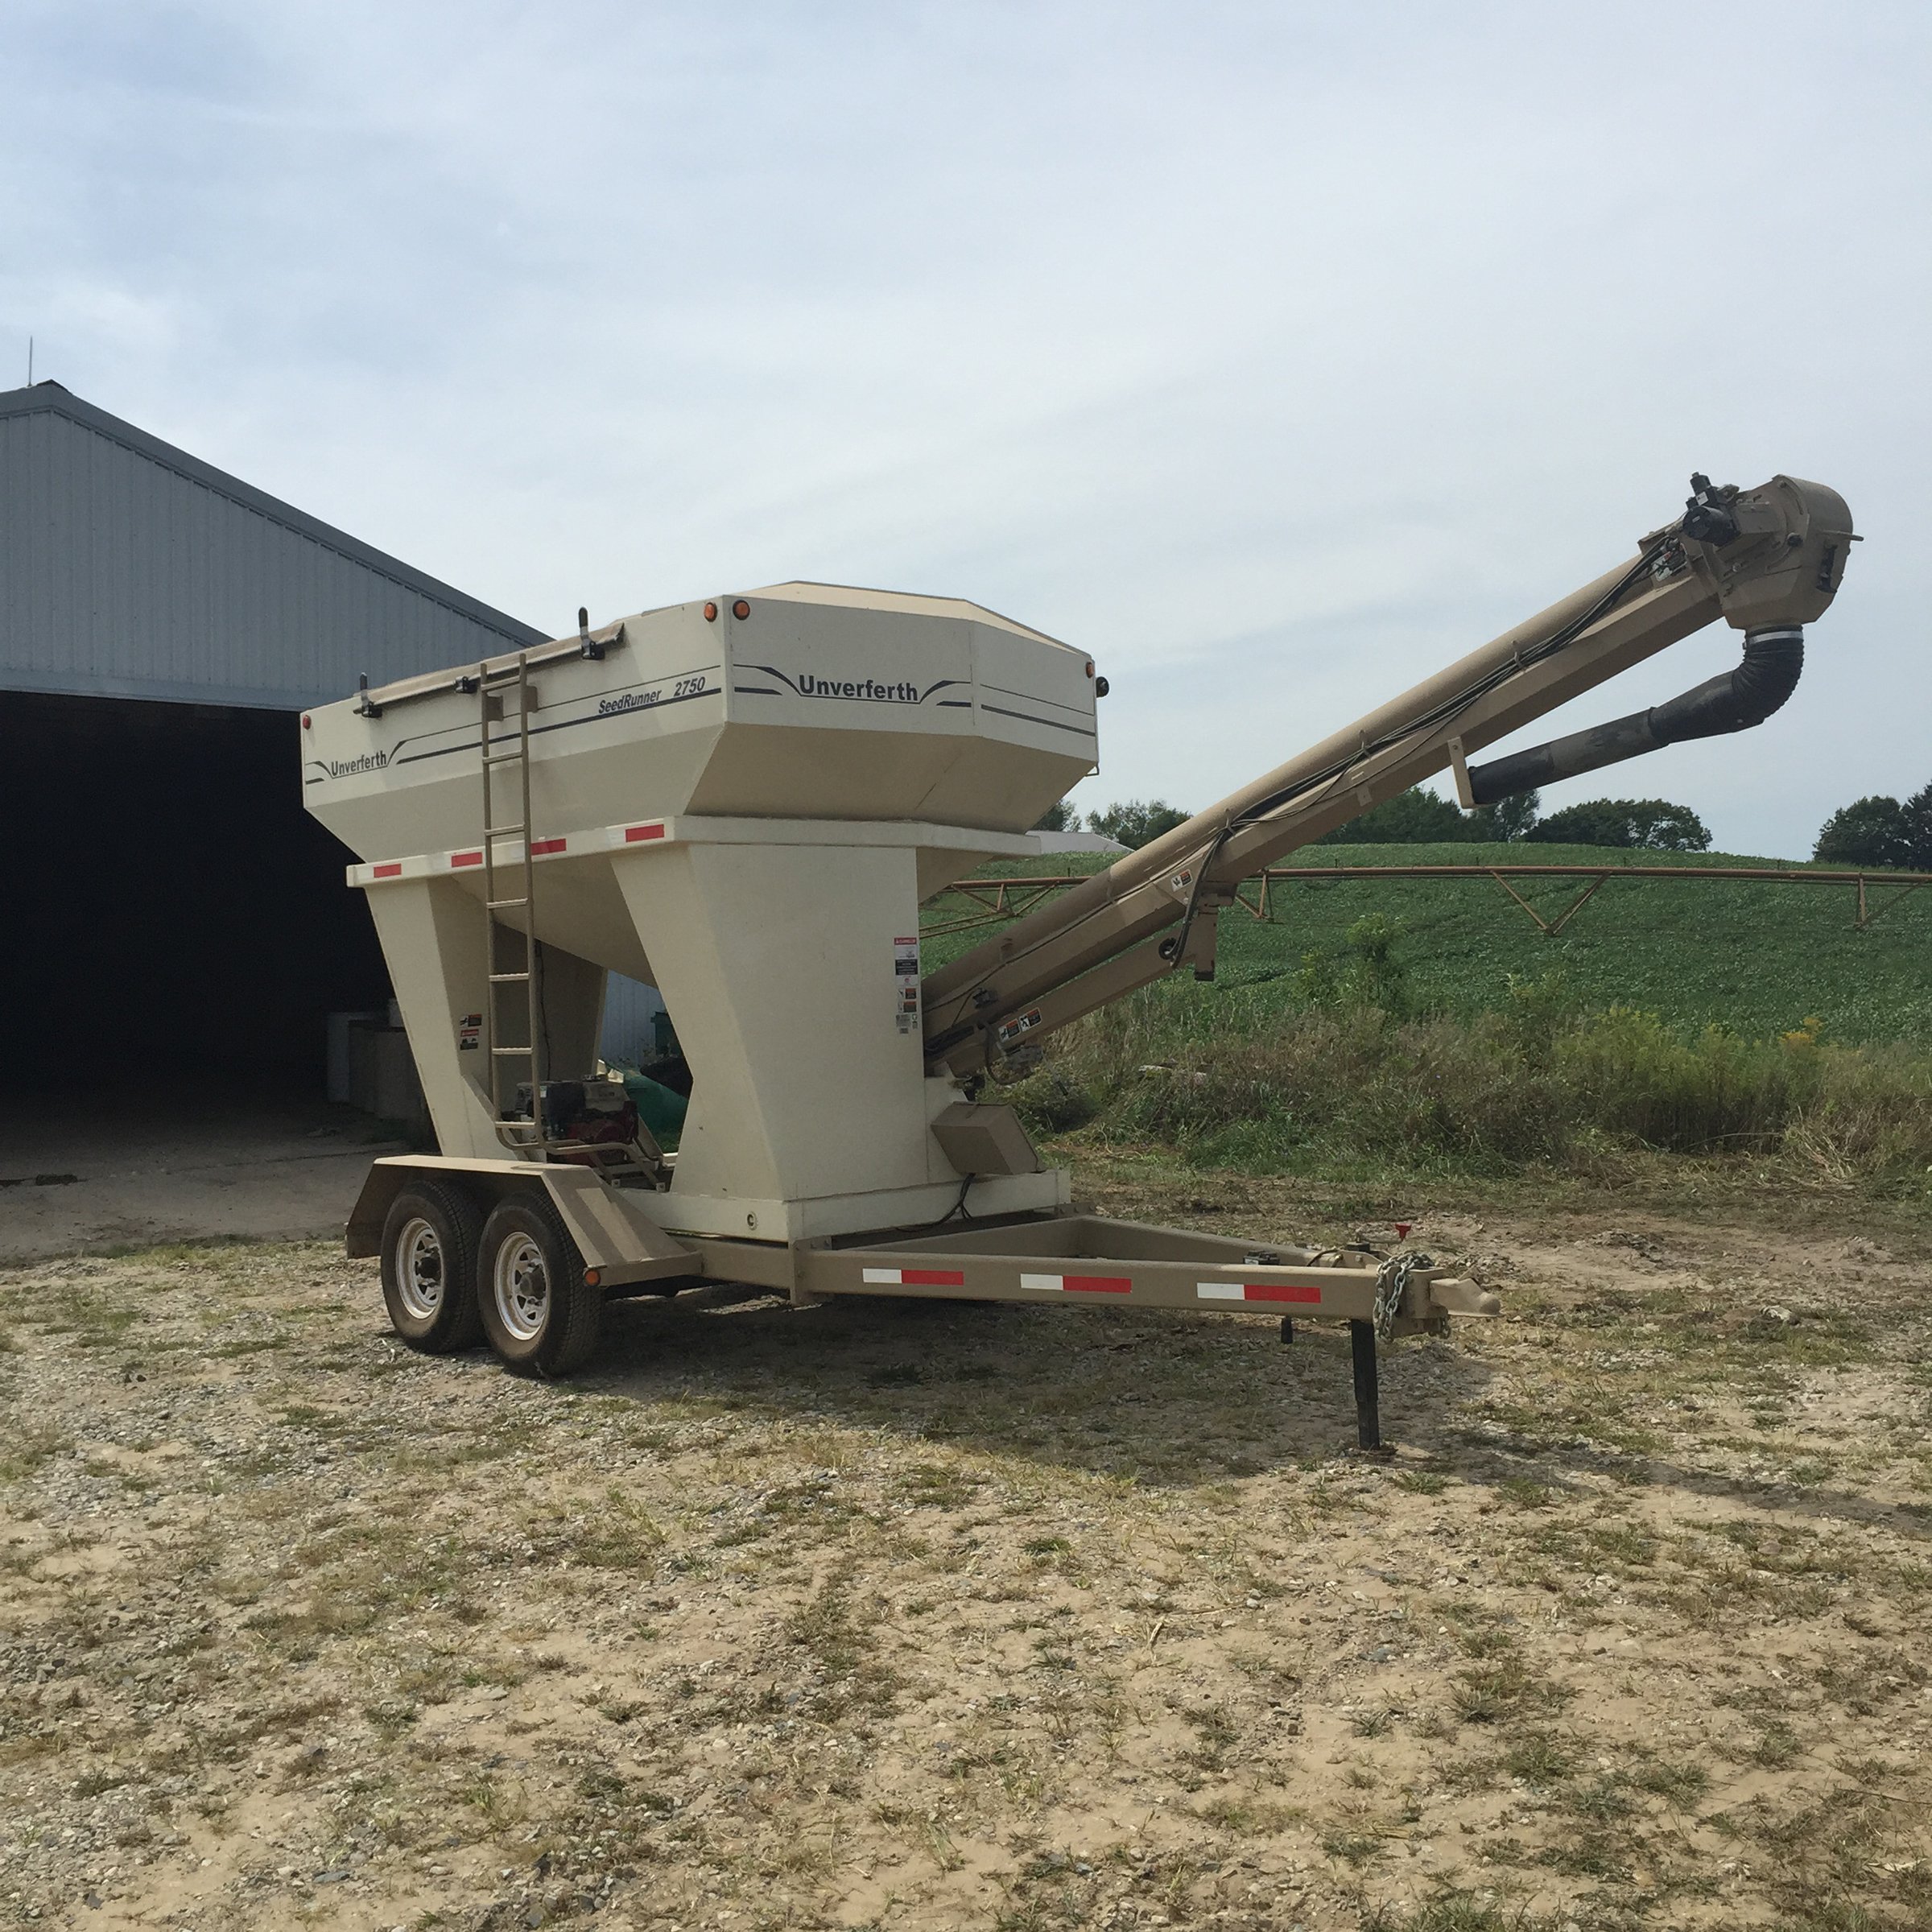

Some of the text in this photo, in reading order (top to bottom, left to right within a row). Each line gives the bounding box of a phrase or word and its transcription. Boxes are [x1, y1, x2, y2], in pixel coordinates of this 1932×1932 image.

[598, 676, 705, 714] SeedRunner 2750
[799, 675, 918, 701] Unverferth
[331, 750, 386, 776] Unverferth
